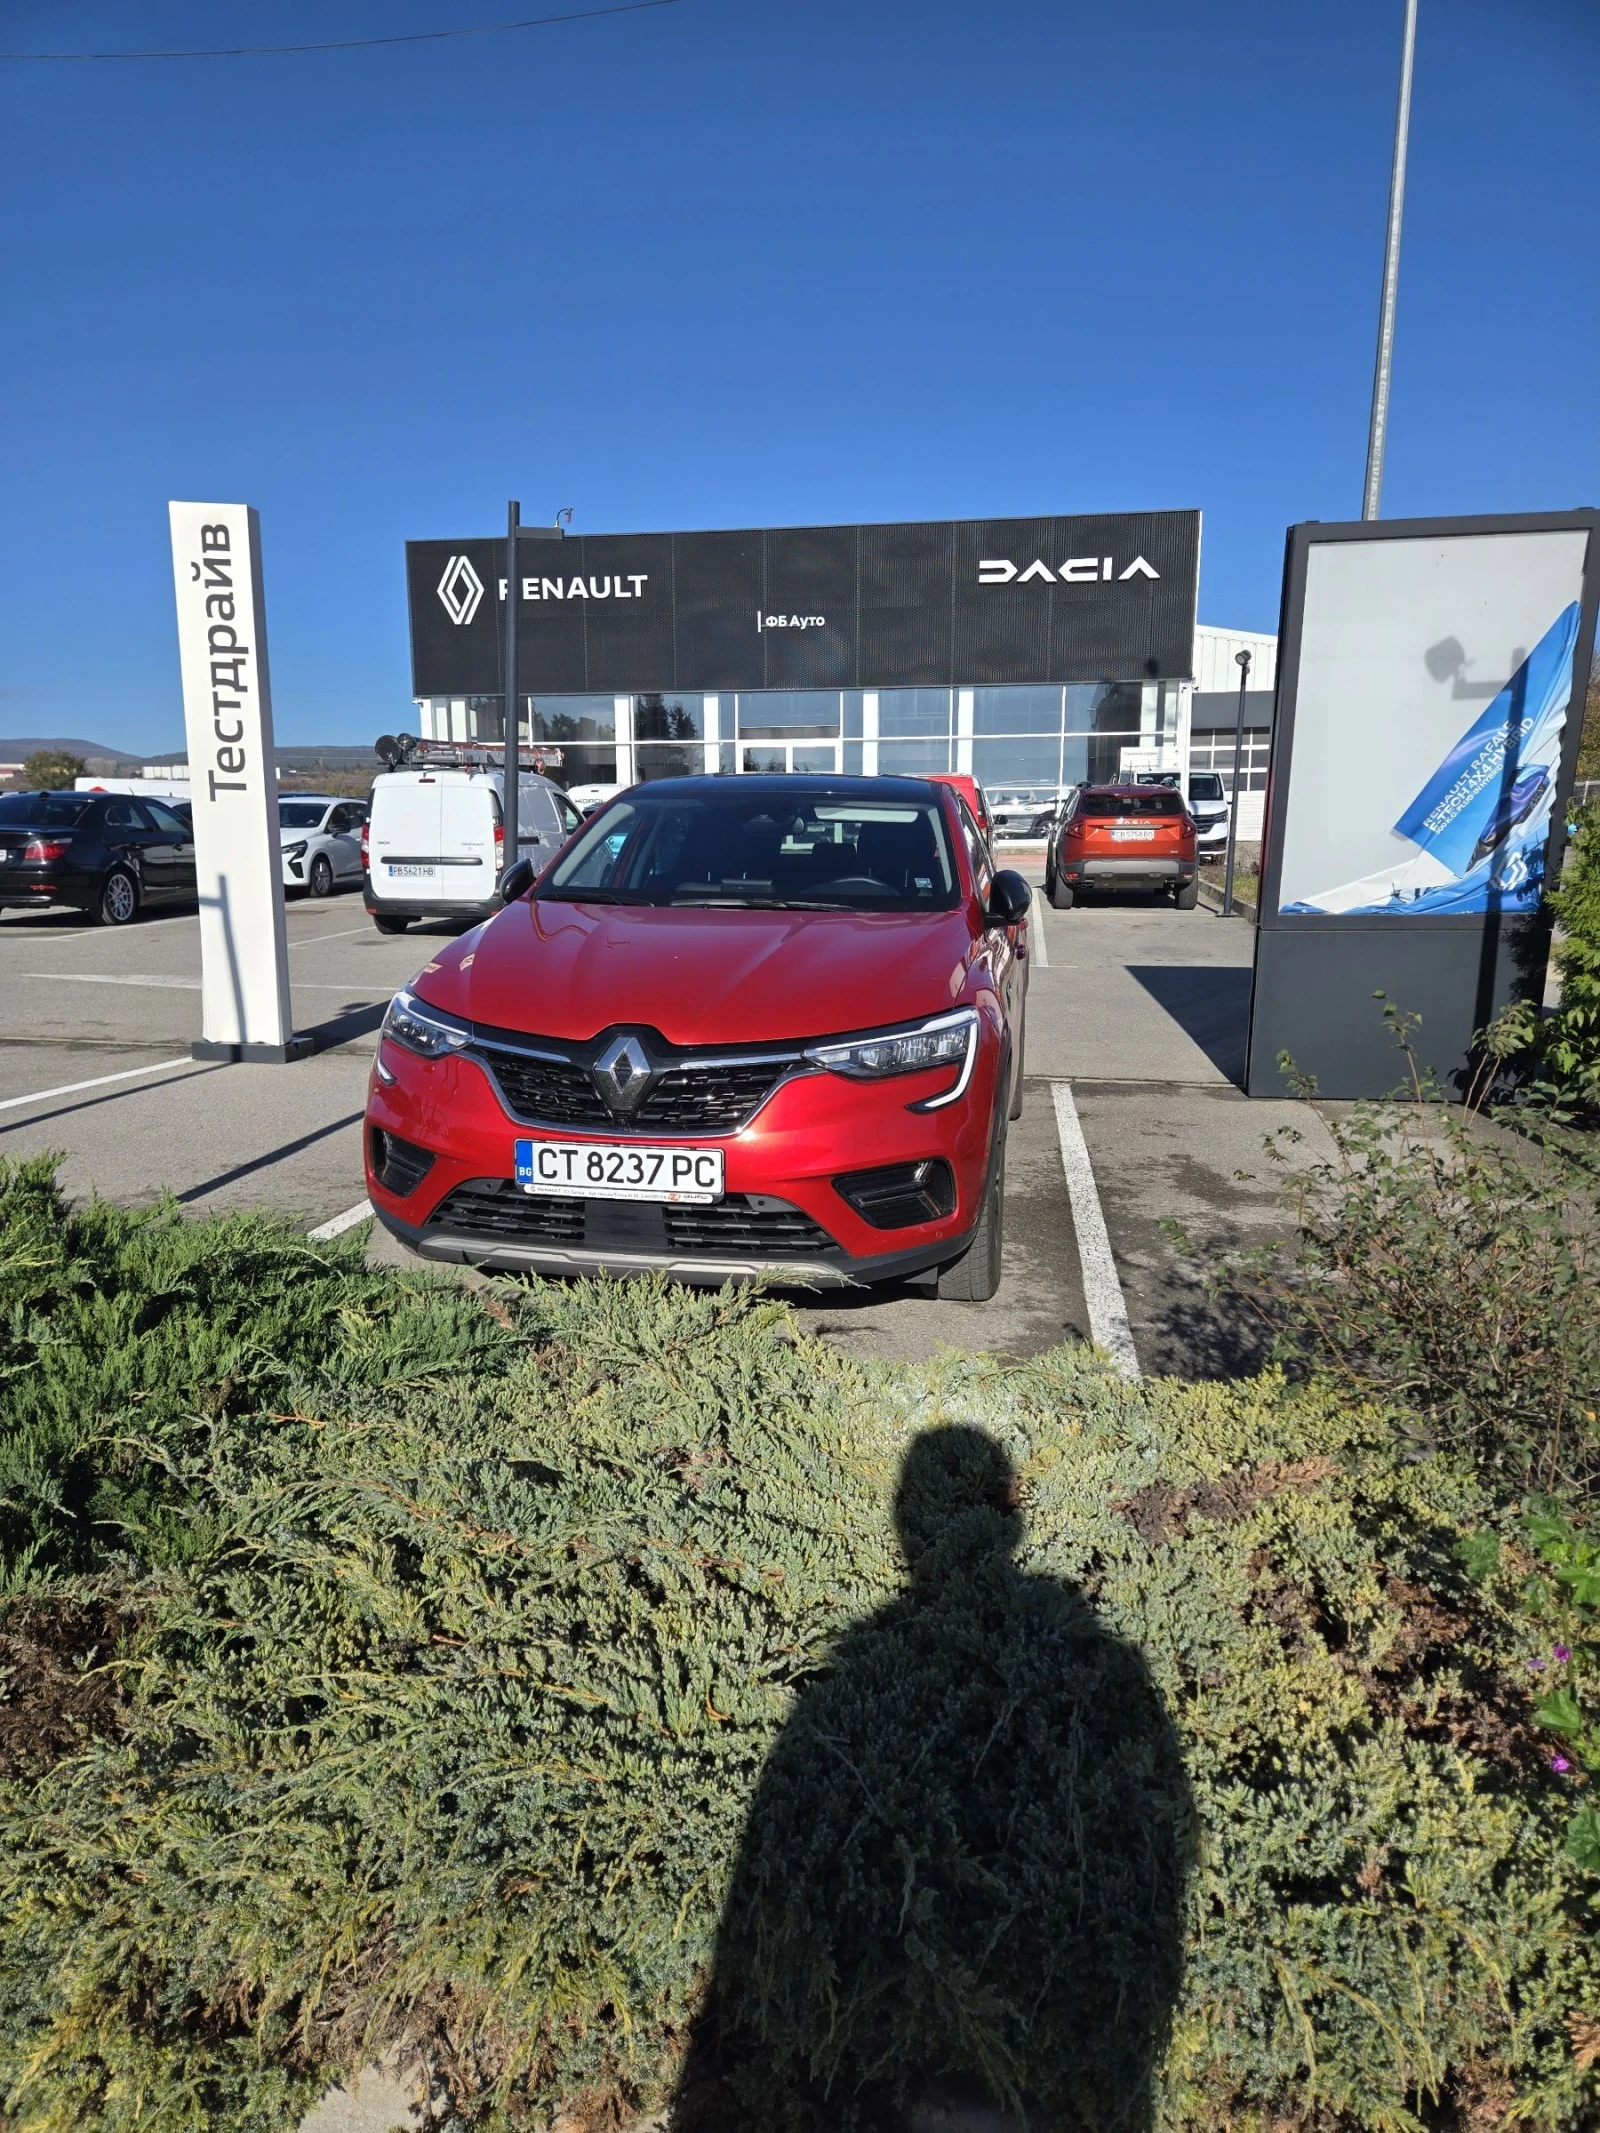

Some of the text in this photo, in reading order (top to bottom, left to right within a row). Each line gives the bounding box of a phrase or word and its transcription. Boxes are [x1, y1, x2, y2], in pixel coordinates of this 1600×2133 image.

[978, 555, 1161, 583] DACIA
[765, 614, 826, 630] ФБ Ауто
[191, 523, 249, 802] Тестдрайв
[1422, 720, 1519, 827] RENAULT RAFALE
[1428, 717, 1534, 832] E-TECH 4X4 HYBRID
[1457, 786, 1482, 811] PLUG-IN
[1481, 764, 1504, 787] HYBRID
[393, 866, 403, 875] PB
[403, 867, 422, 876] 5621
[519, 1167, 532, 1176] BG
[538, 1148, 716, 1187] CT 8237 PC
